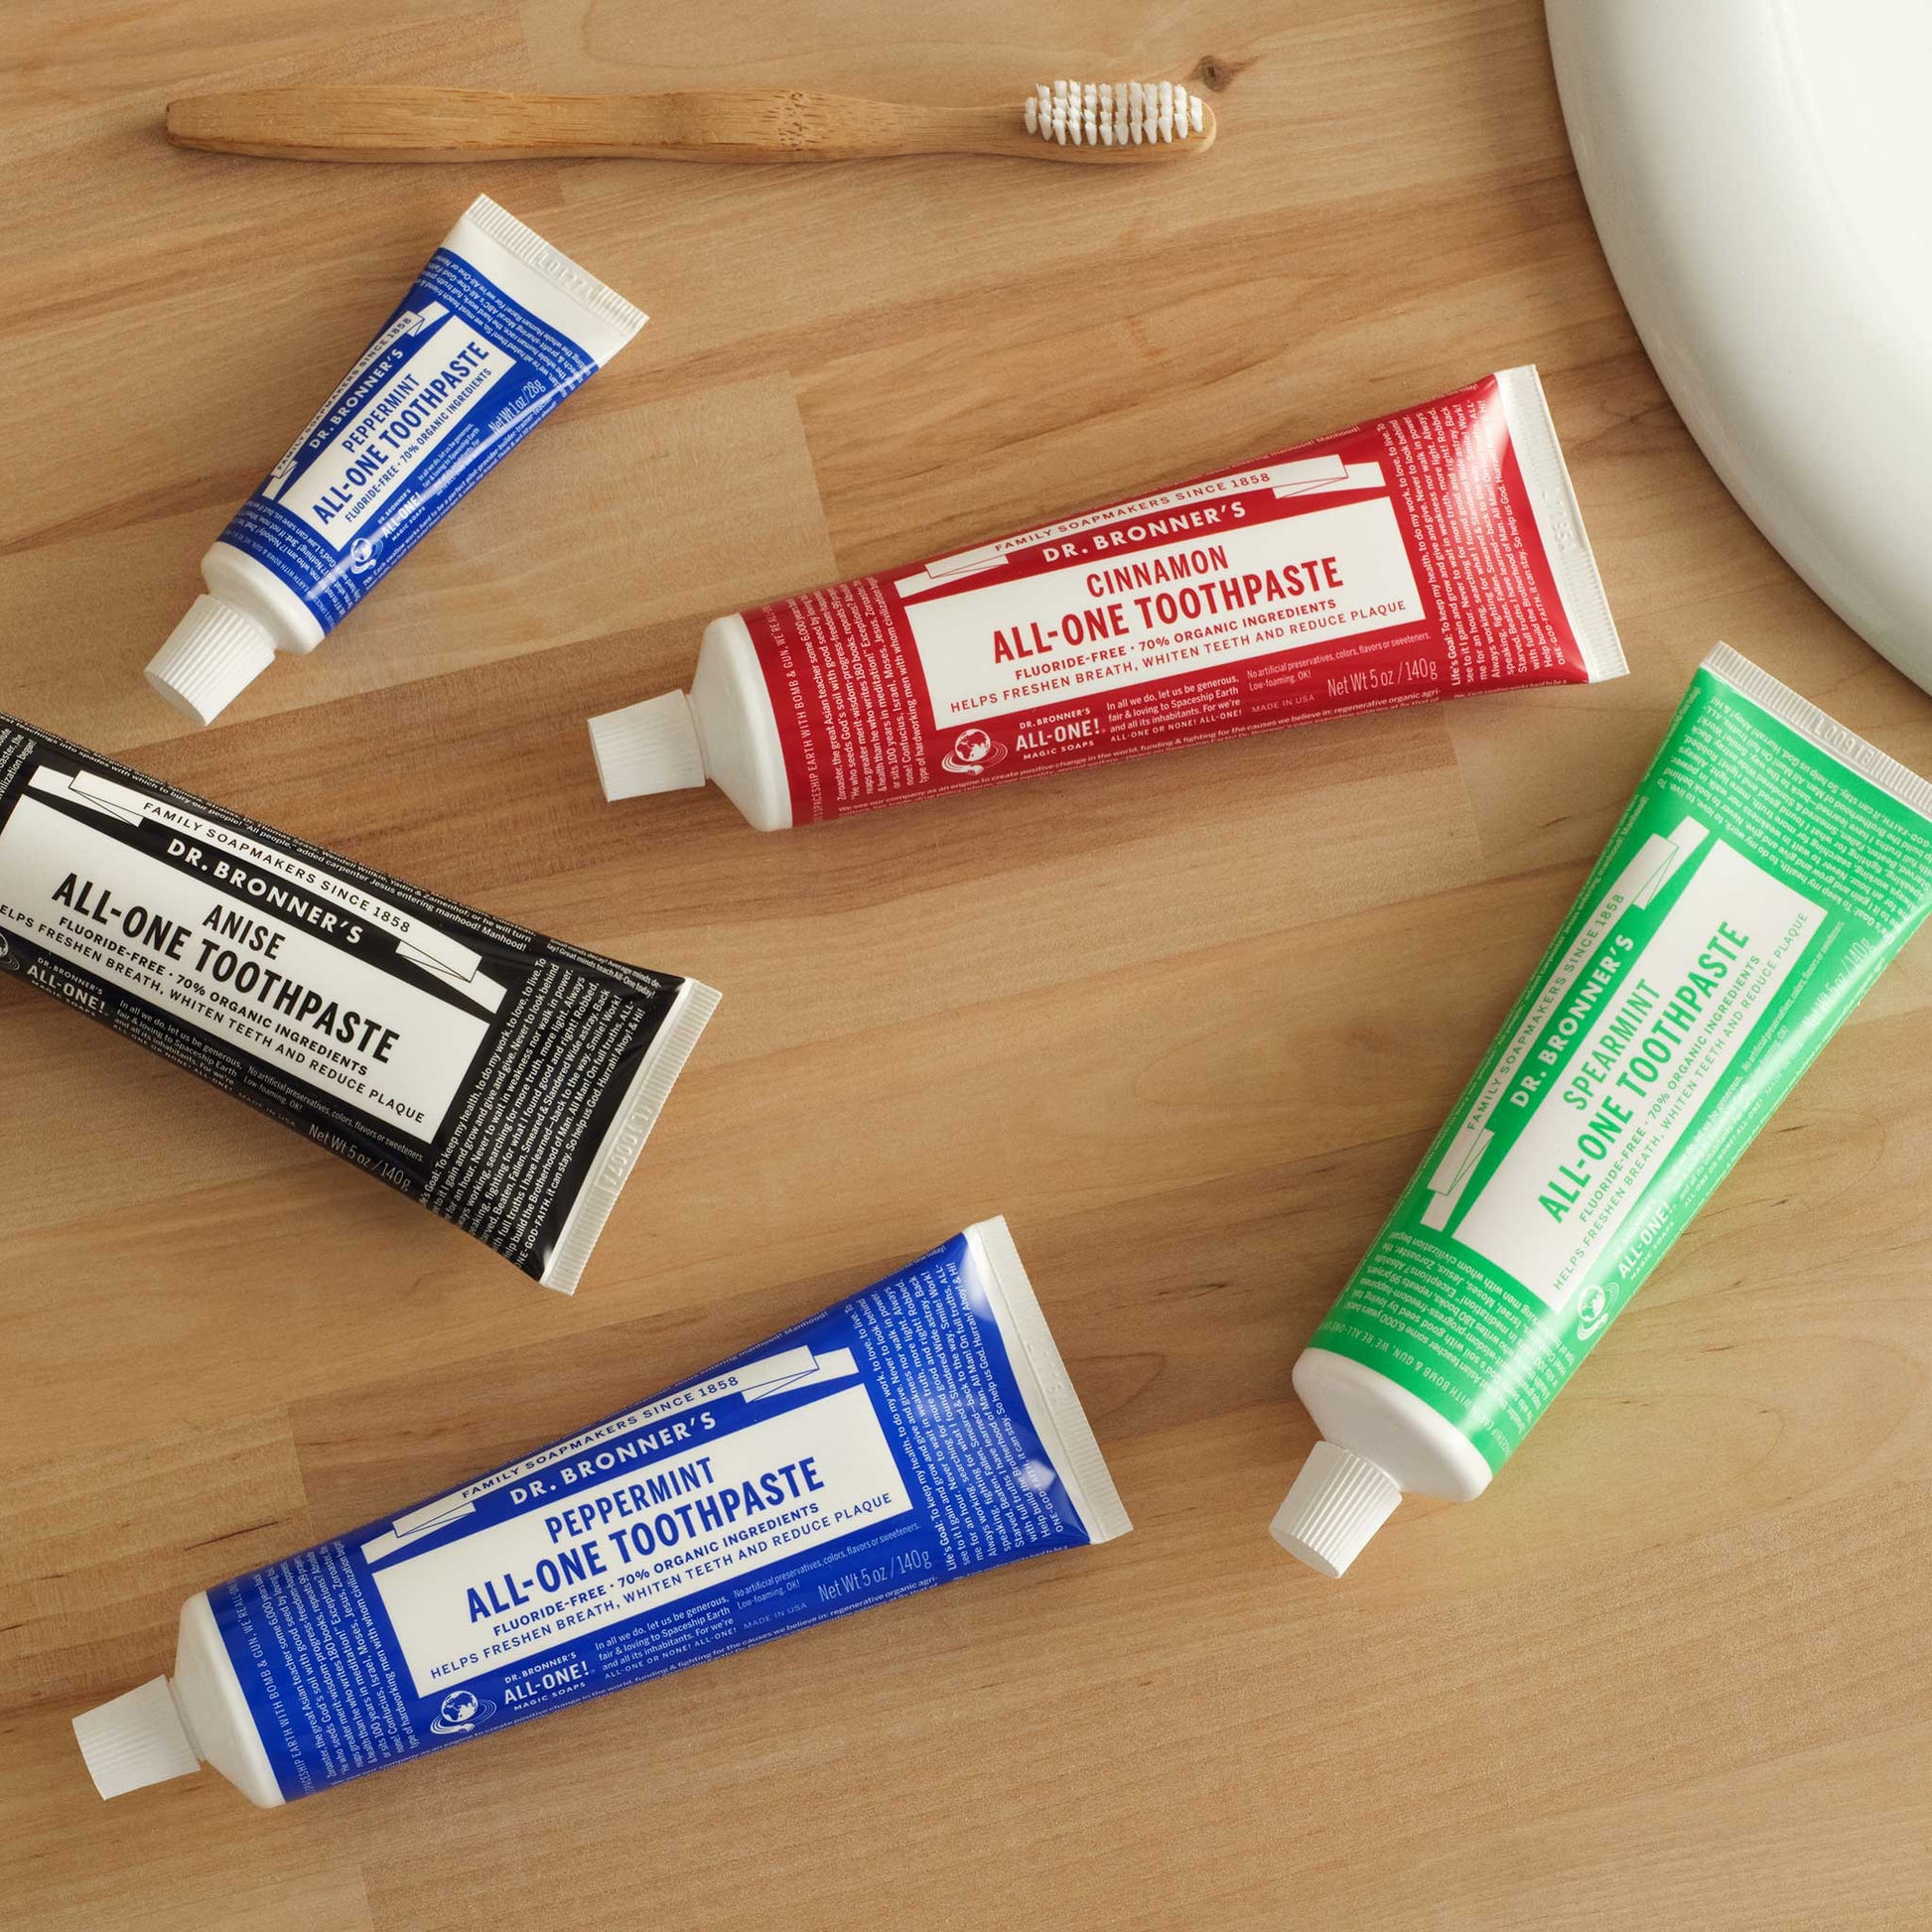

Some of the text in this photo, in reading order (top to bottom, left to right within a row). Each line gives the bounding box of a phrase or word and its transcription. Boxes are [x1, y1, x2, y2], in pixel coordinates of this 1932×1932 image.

[276, 317, 412, 471] FAMILY SOAPMAKERS SINCE 1858
[308, 348, 404, 449] DR. BRONNER'S
[312, 443, 390, 525] ALL-ONE
[378, 341, 490, 449] TOOTHPASTE
[341, 373, 420, 453] PEPPERMINT
[514, 395, 527, 409] oz
[522, 378, 546, 398] 28g
[344, 465, 399, 523] FLUORIDE-FREE
[399, 444, 420, 463] 70%
[416, 412, 449, 446] ORGANIC
[445, 368, 492, 415] INGREDIENTS
[381, 491, 424, 538] ALL-ONE!
[993, 473, 1270, 552] FAMILY SOAPMAKERS SINCE 1858
[1042, 501, 1246, 562] DR. BRONNER'S
[993, 556, 1344, 664] ALL-ONE TOOTHPASTE
[1086, 545, 1229, 598] CINNAMON
[950, 600, 1406, 713] HELPS FRESHEN BREATH, WHITEN TEETH AND REDUCE PLAQUE
[1014, 599, 1337, 680] FLUORIDE-FREE 70% ORGANIC INGREDIENTS
[1327, 657, 1438, 697] Net Wt 5 oz 140g
[1016, 718, 1100, 752] ALL-ONE!
[1019, 707, 1091, 730] DR. BRONNER'S
[1106, 675, 1239, 711] In all we do, let us be generous,
[1108, 686, 1239, 722] fair & loving to Spaceship Earth
[1023, 740, 1095, 761] MAGIC SOAPS
[143, 802, 411, 933] FAMILY SOAPMAKERS SINCE 1858
[167, 838, 363, 944] DR. BRONNER'S
[51, 872, 400, 1064] ALL-ONE TOOTHPASTE
[201, 904, 286, 961] ANISE
[0, 904, 425, 1124] ELPS FRESHEN BREATH, WHITEN TEETH AND REDUCE PLAQUE
[27, 964, 106, 1014] ALL-ONE!
[37, 957, 103, 995] DR. BRONNER'S
[58, 916, 368, 1076] FLUORIDE-FREE 70% ORGANIC INGREDIENTS
[1466, 894, 1624, 1131] FAMILY SOAPMAKERS SINCE 1858
[1510, 934, 1634, 1108] DR. BRONNER'S
[1562, 978, 1660, 1111] SPEARMINT
[1538, 1094, 1634, 1224] ALL-ONE
[1615, 921, 1750, 1098] TOOTHPASTE
[1553, 1248, 1585, 1291] HELPS
[1582, 1187, 1626, 1247] FRESHEN
[1623, 1134, 1665, 1187] BREATH,
[1660, 1080, 1698, 1130] WHITEN
[1694, 1037, 1726, 1078] TEETH
[1723, 1010, 1743, 1038] AND
[1740, 960, 1778, 1009] REDUCE
[1773, 912, 1808, 959] PLAQUE
[1578, 1126, 1647, 1223] FLUORIDE-FREE
[1647, 1093, 1670, 1120] 70%
[1667, 1035, 1707, 1090] ORGANIC
[1703, 955, 1760, 1035] INGREDIENTS
[307, 1124, 412, 1192] Net Wt 5 oz 140g
[1619, 1200, 1673, 1279] ALL-ONE!
[1630, 1221, 1675, 1281] MAGIC SOAPS
[461, 1376, 739, 1499] FAMILY SOAPMAKERS SINCE 1858
[509, 1411, 716, 1505] DR. BRONNER'S
[466, 1456, 825, 1623] ALL-ONE TOOTHPASTE
[545, 1456, 714, 1544] PEPPERMINT
[430, 1492, 892, 1679] HELPS FRESHEN BREATH, WHITEN TEETH AND REDUCE PLAQUE
[493, 1503, 819, 1637] FLUORIDE-FREE 70% ORGANIC INGREDIENTS
[817, 1549, 933, 1602] Net Wt 5 oz 140g
[504, 1651, 577, 1684] DR. BRONNER'S
[505, 1660, 590, 1705] ALL-ONE!
[513, 1681, 586, 1711] MAGIC SOAPS
